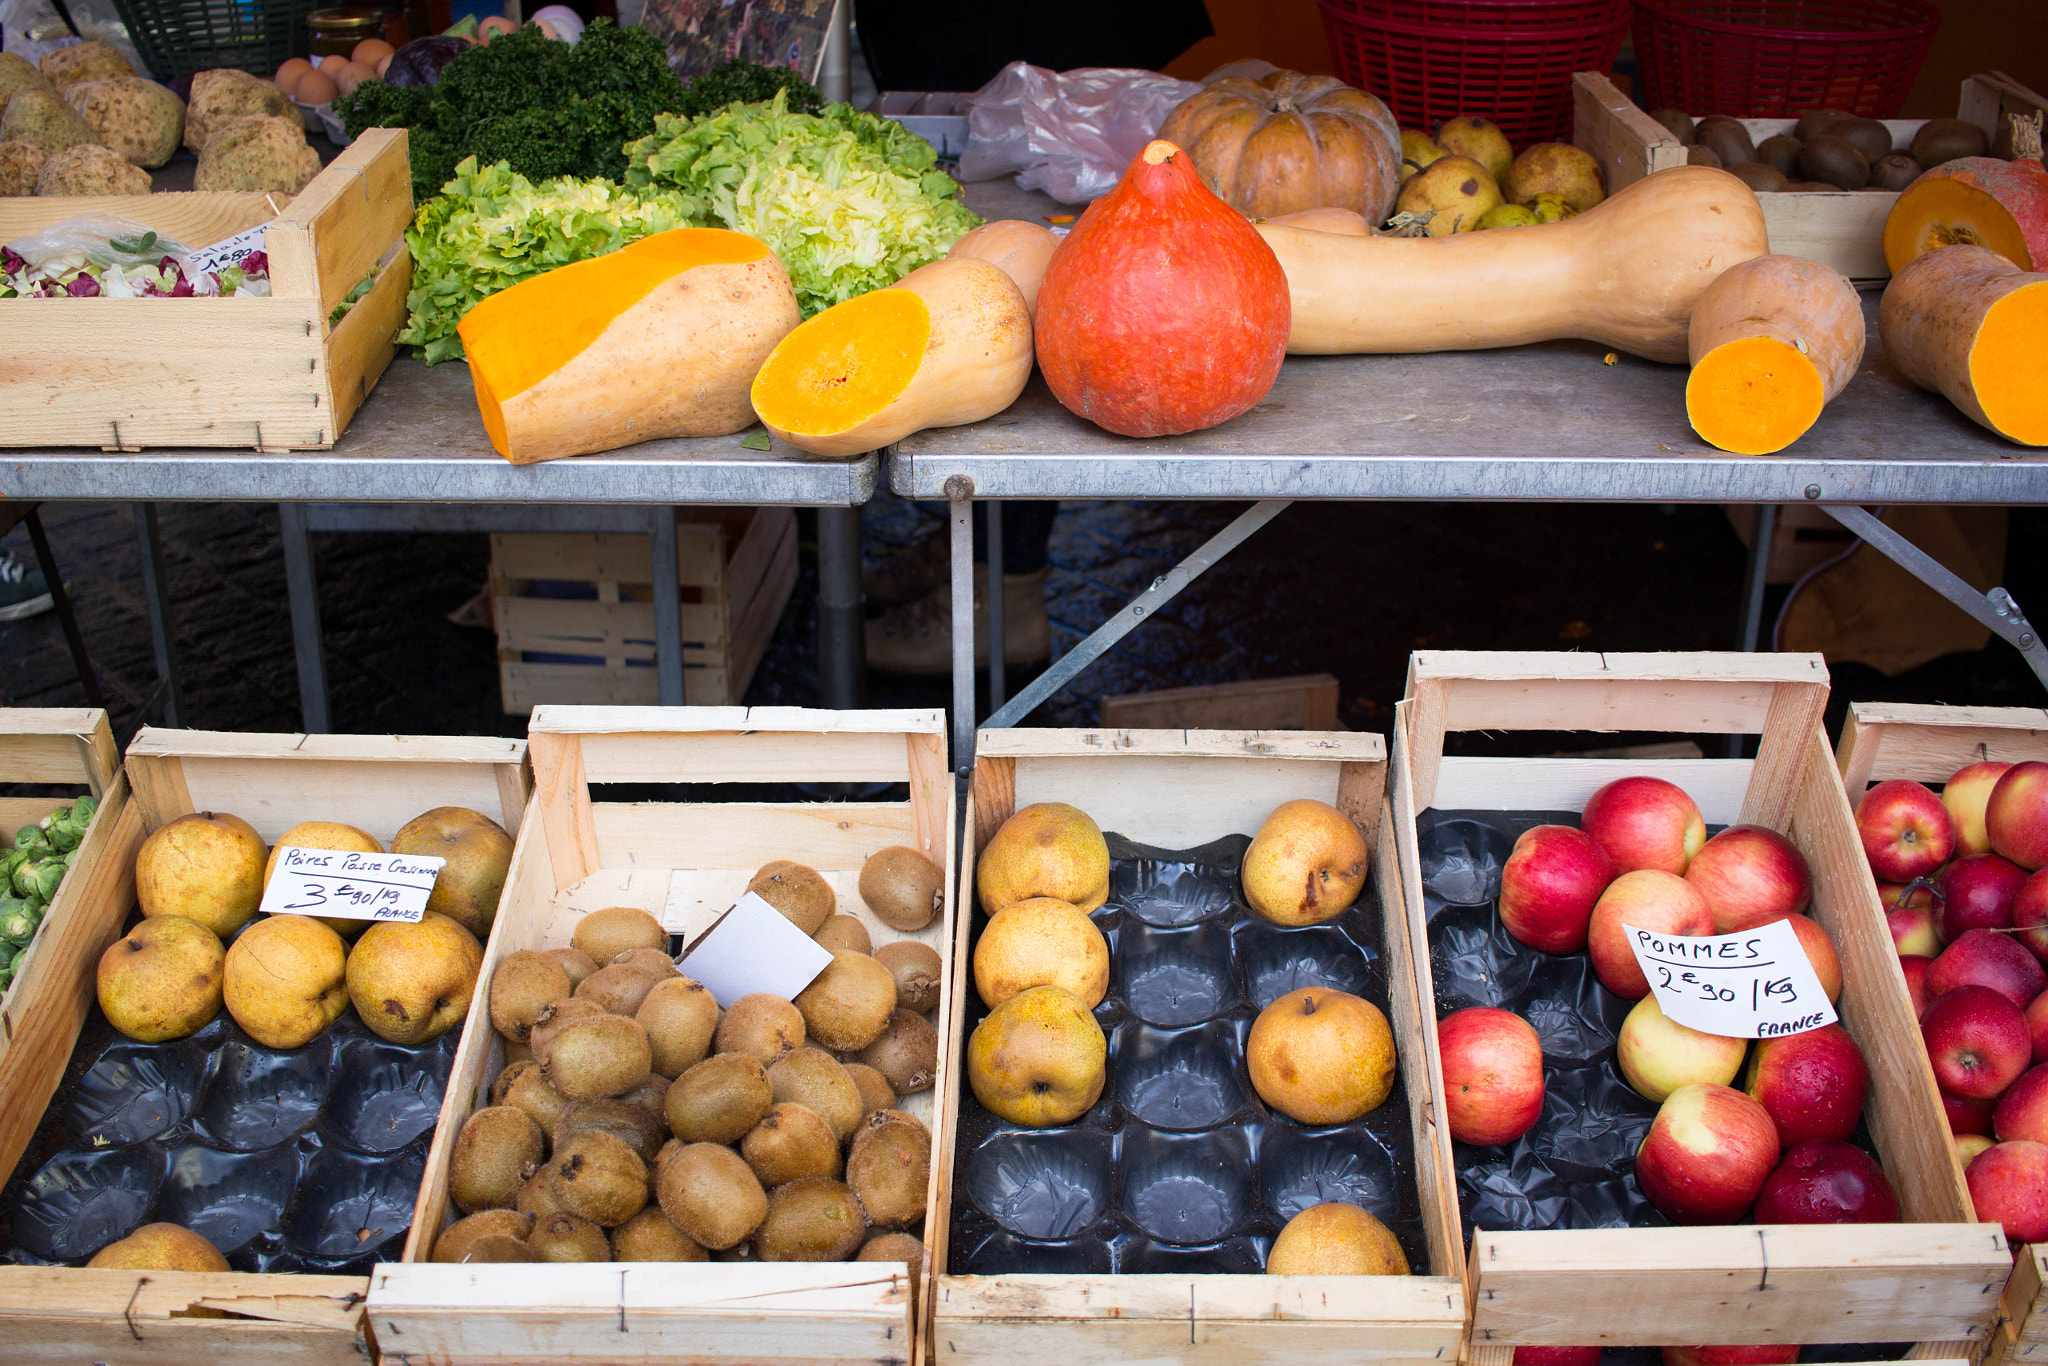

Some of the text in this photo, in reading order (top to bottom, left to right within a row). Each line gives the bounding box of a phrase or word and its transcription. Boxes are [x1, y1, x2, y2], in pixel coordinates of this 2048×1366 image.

[284, 848, 333, 867] Poires
[341, 853, 382, 870] Passe
[1637, 930, 1761, 959] POMMES
[1757, 1012, 1824, 1037] FRANCE
